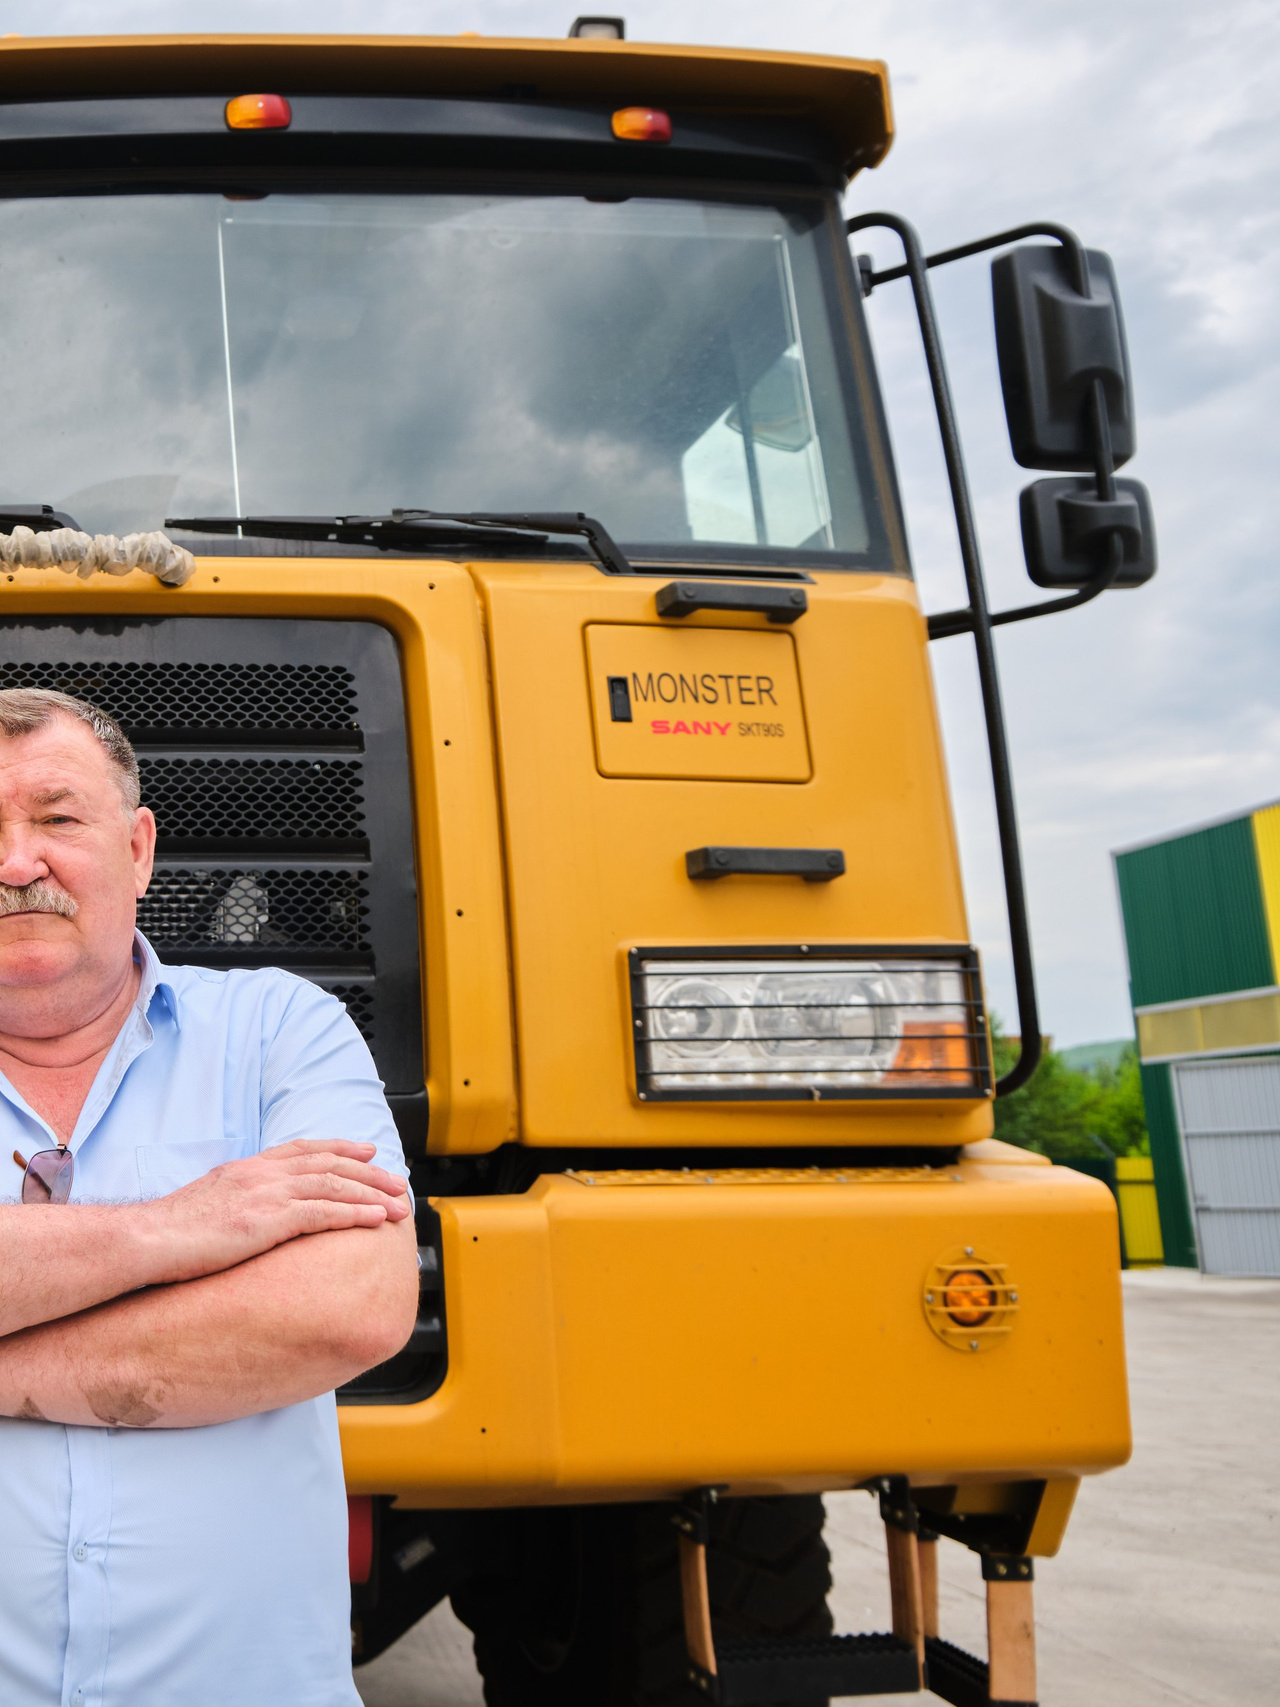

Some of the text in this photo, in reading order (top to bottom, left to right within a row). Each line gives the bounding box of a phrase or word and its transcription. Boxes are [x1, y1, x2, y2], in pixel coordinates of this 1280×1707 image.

[632, 672, 778, 706] MONSTER
[650, 719, 785, 738] SANY SKT90S
